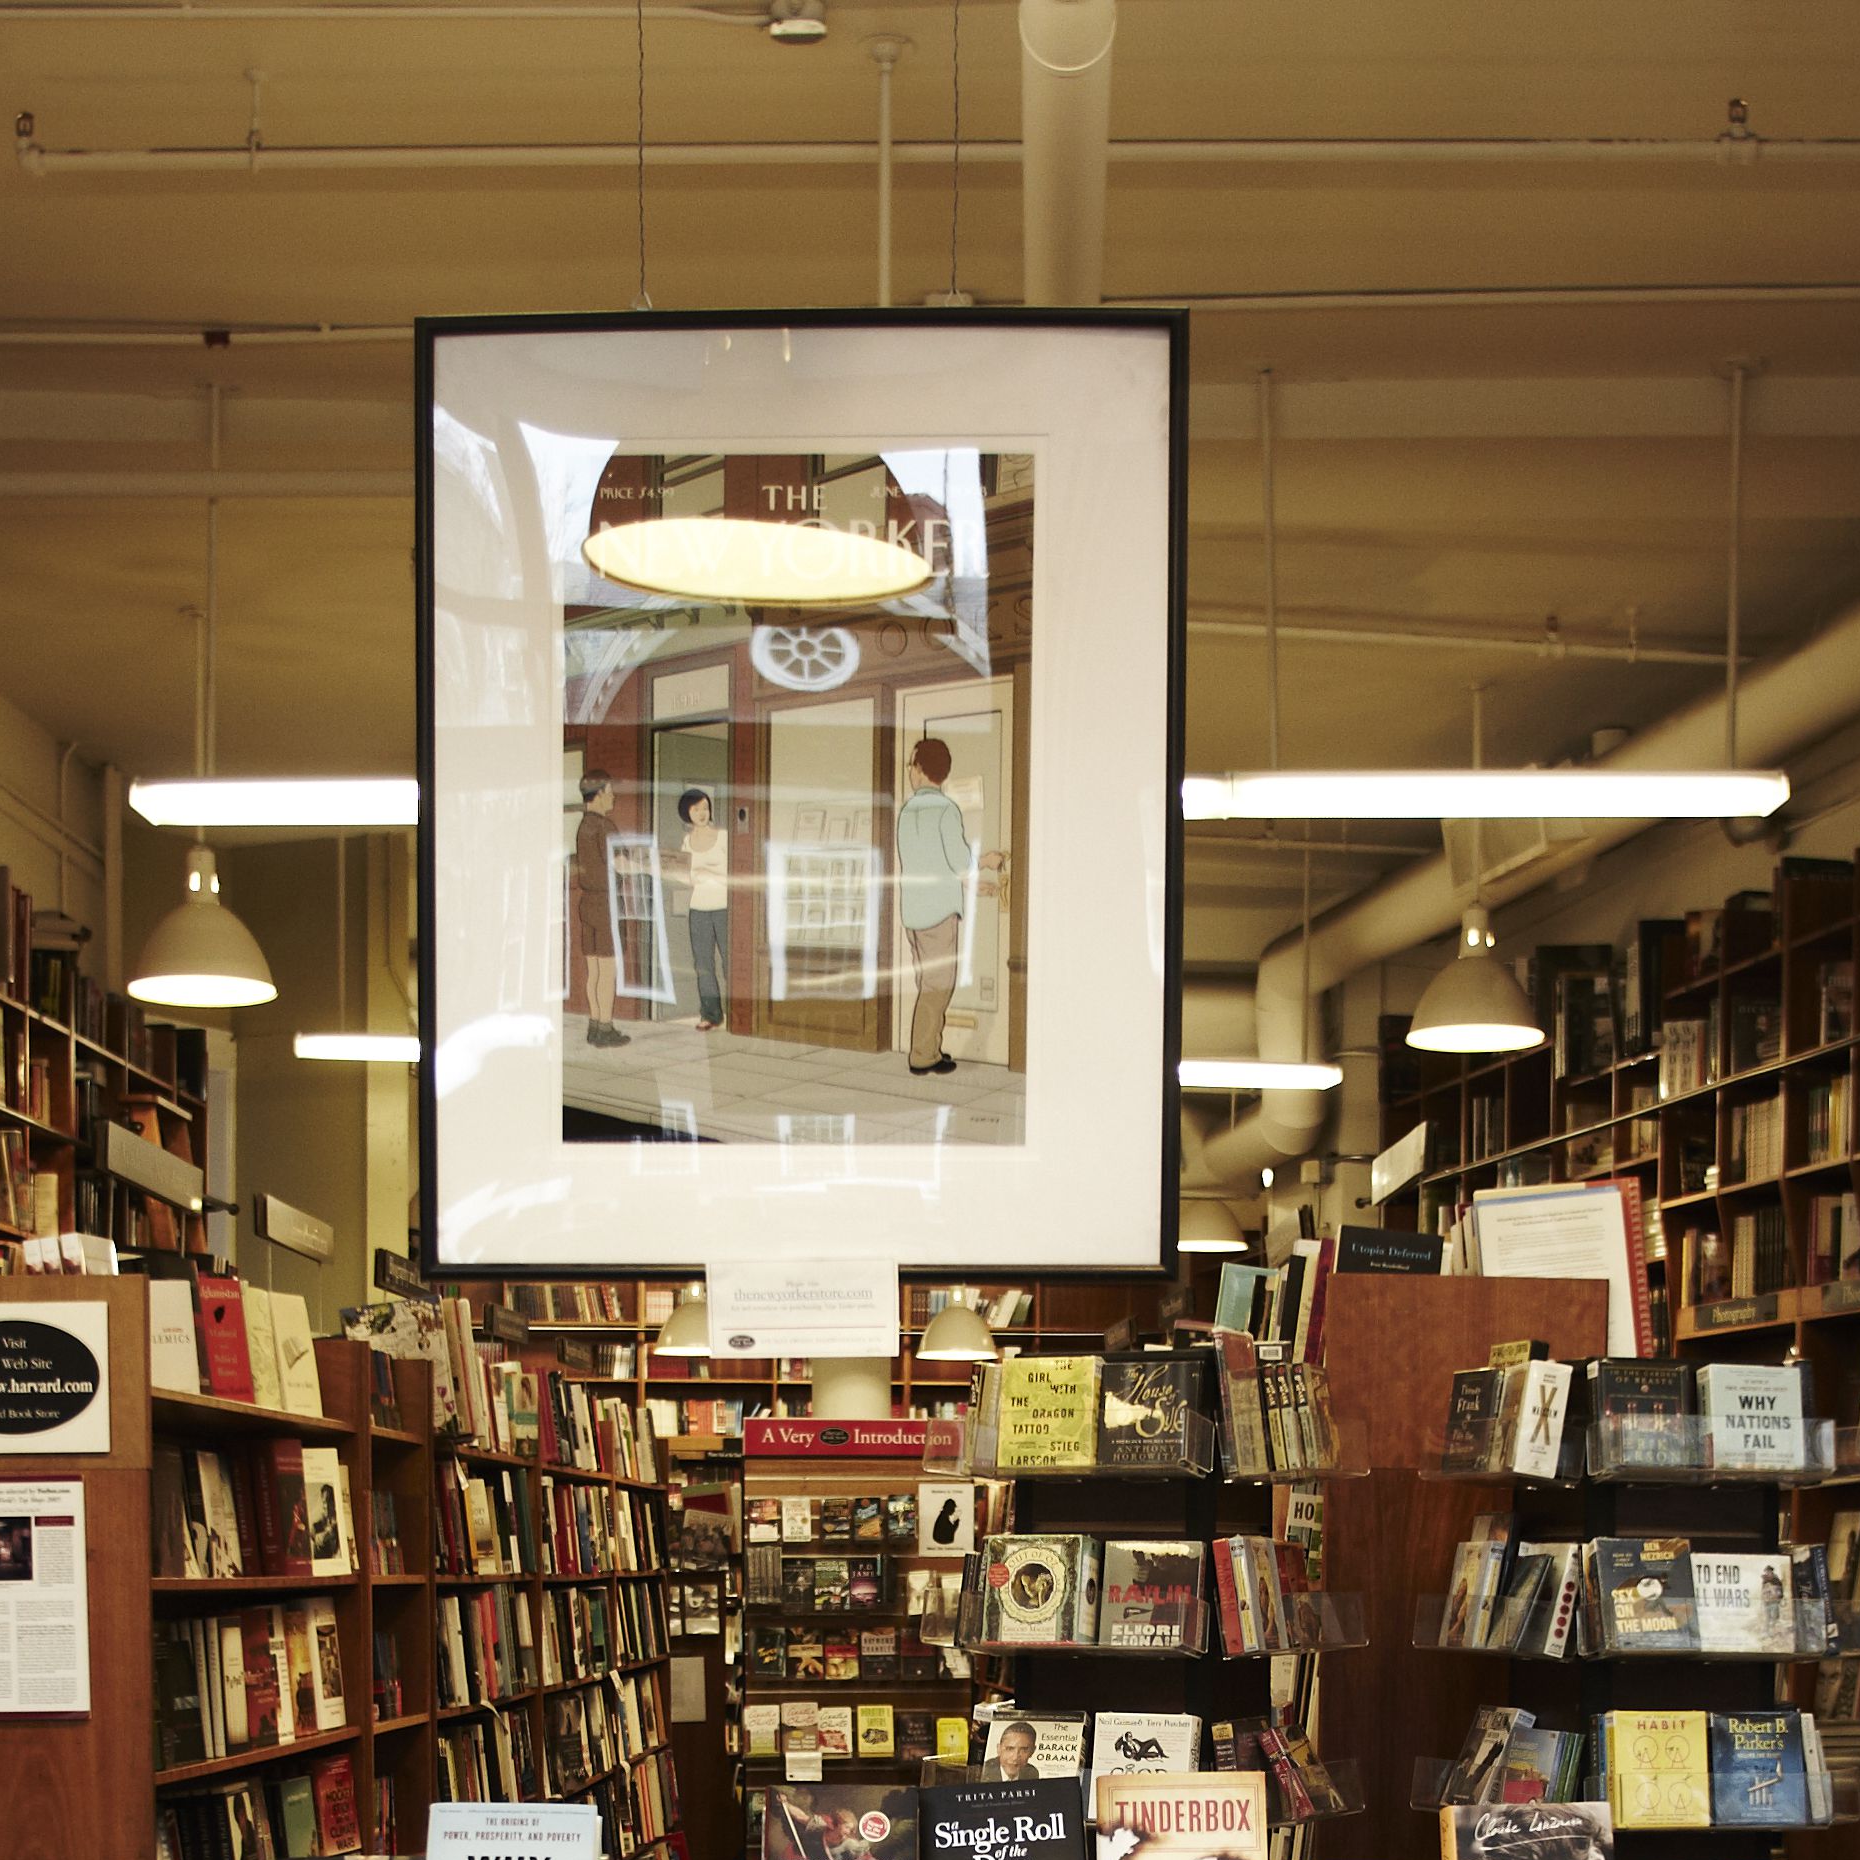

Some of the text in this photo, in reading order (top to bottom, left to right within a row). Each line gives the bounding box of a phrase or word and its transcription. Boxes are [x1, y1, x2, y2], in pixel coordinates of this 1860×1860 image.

[2, 1337, 27, 1349] Visit
[2, 1358, 24, 1371] Web
[29, 1358, 52, 1371] Site
[1738, 1396, 1776, 1411] WHY
[9, 1408, 31, 1419] Book
[34, 1408, 60, 1419] Store
[1726, 1415, 1791, 1431] NATIONS
[761, 1429, 952, 1449] A Very Introduction
[1743, 1435, 1775, 1450] FAIL
[1638, 1719, 1686, 1731] HABIT
[1115, 1799, 1251, 1832] TINDERBOX
[443, 1831, 472, 1841] POWER,
[528, 1832, 543, 1842] AND
[546, 1832, 581, 1843] POVERTY
[935, 1819, 1011, 1850] Single
[1015, 1812, 1066, 1841] Roll
[995, 1844, 1027, 1859] of the
